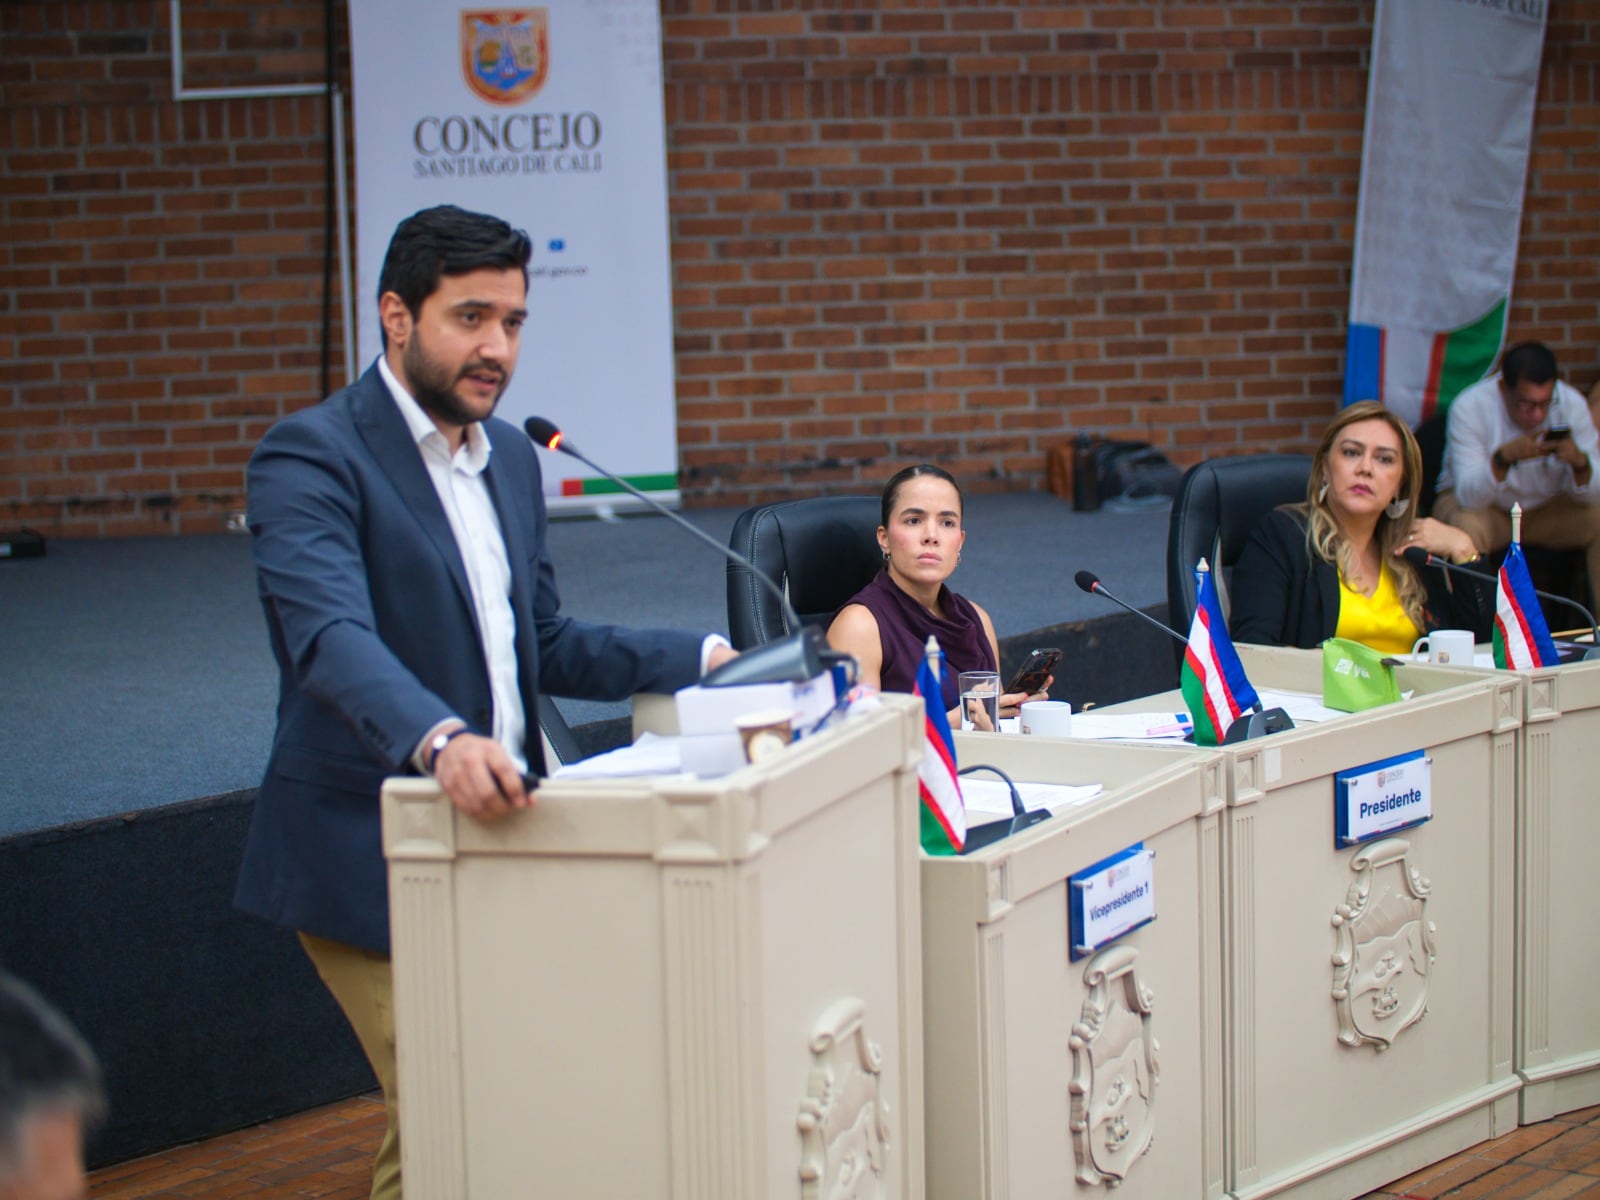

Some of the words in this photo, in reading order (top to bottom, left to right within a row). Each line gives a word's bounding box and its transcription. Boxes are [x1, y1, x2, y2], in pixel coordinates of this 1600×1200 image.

[414, 112, 601, 154] CONCEJO
[413, 154, 519, 178] SANTIAGO
[522, 153, 548, 174] DE
[553, 151, 602, 173] CALI
[1360, 787, 1421, 818] Presidente
[1090, 885, 1144, 920] Vicepresidente
[1144, 880, 1149, 894] 1
